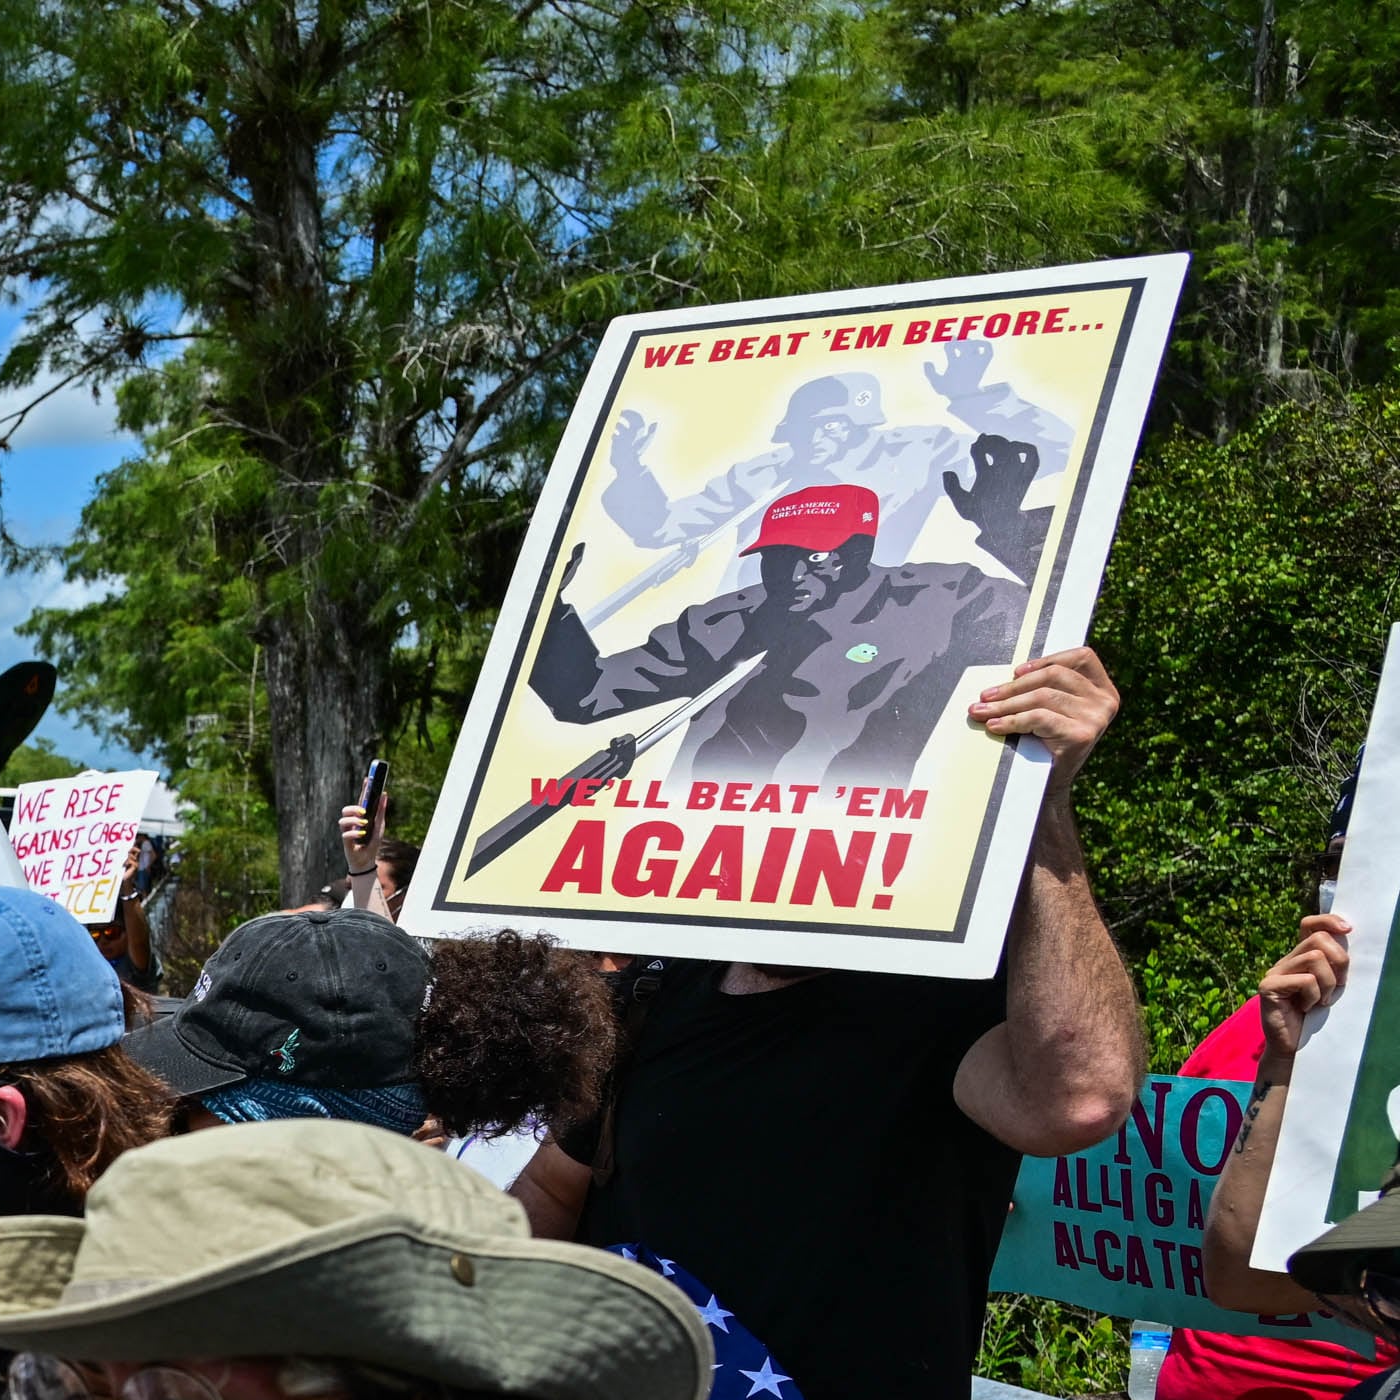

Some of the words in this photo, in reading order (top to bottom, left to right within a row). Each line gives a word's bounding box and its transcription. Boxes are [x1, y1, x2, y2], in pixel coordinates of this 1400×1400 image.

[644, 342, 700, 369] WE
[708, 331, 809, 362] BEAT
[902, 307, 1103, 344] BEFORE...
[771, 509, 802, 520] GREAT
[772, 504, 798, 513] MAKE
[18, 789, 55, 825] WE
[64, 784, 124, 819] RISE
[530, 777, 671, 809] WE'LL
[686, 781, 819, 815] BEAT
[88, 822, 137, 846] CAGES
[24, 860, 54, 886] WE
[62, 849, 119, 881] RISE
[539, 819, 913, 910] AGAIN!
[66, 874, 118, 914] ICE!
[1114, 1082, 1245, 1176] NO
